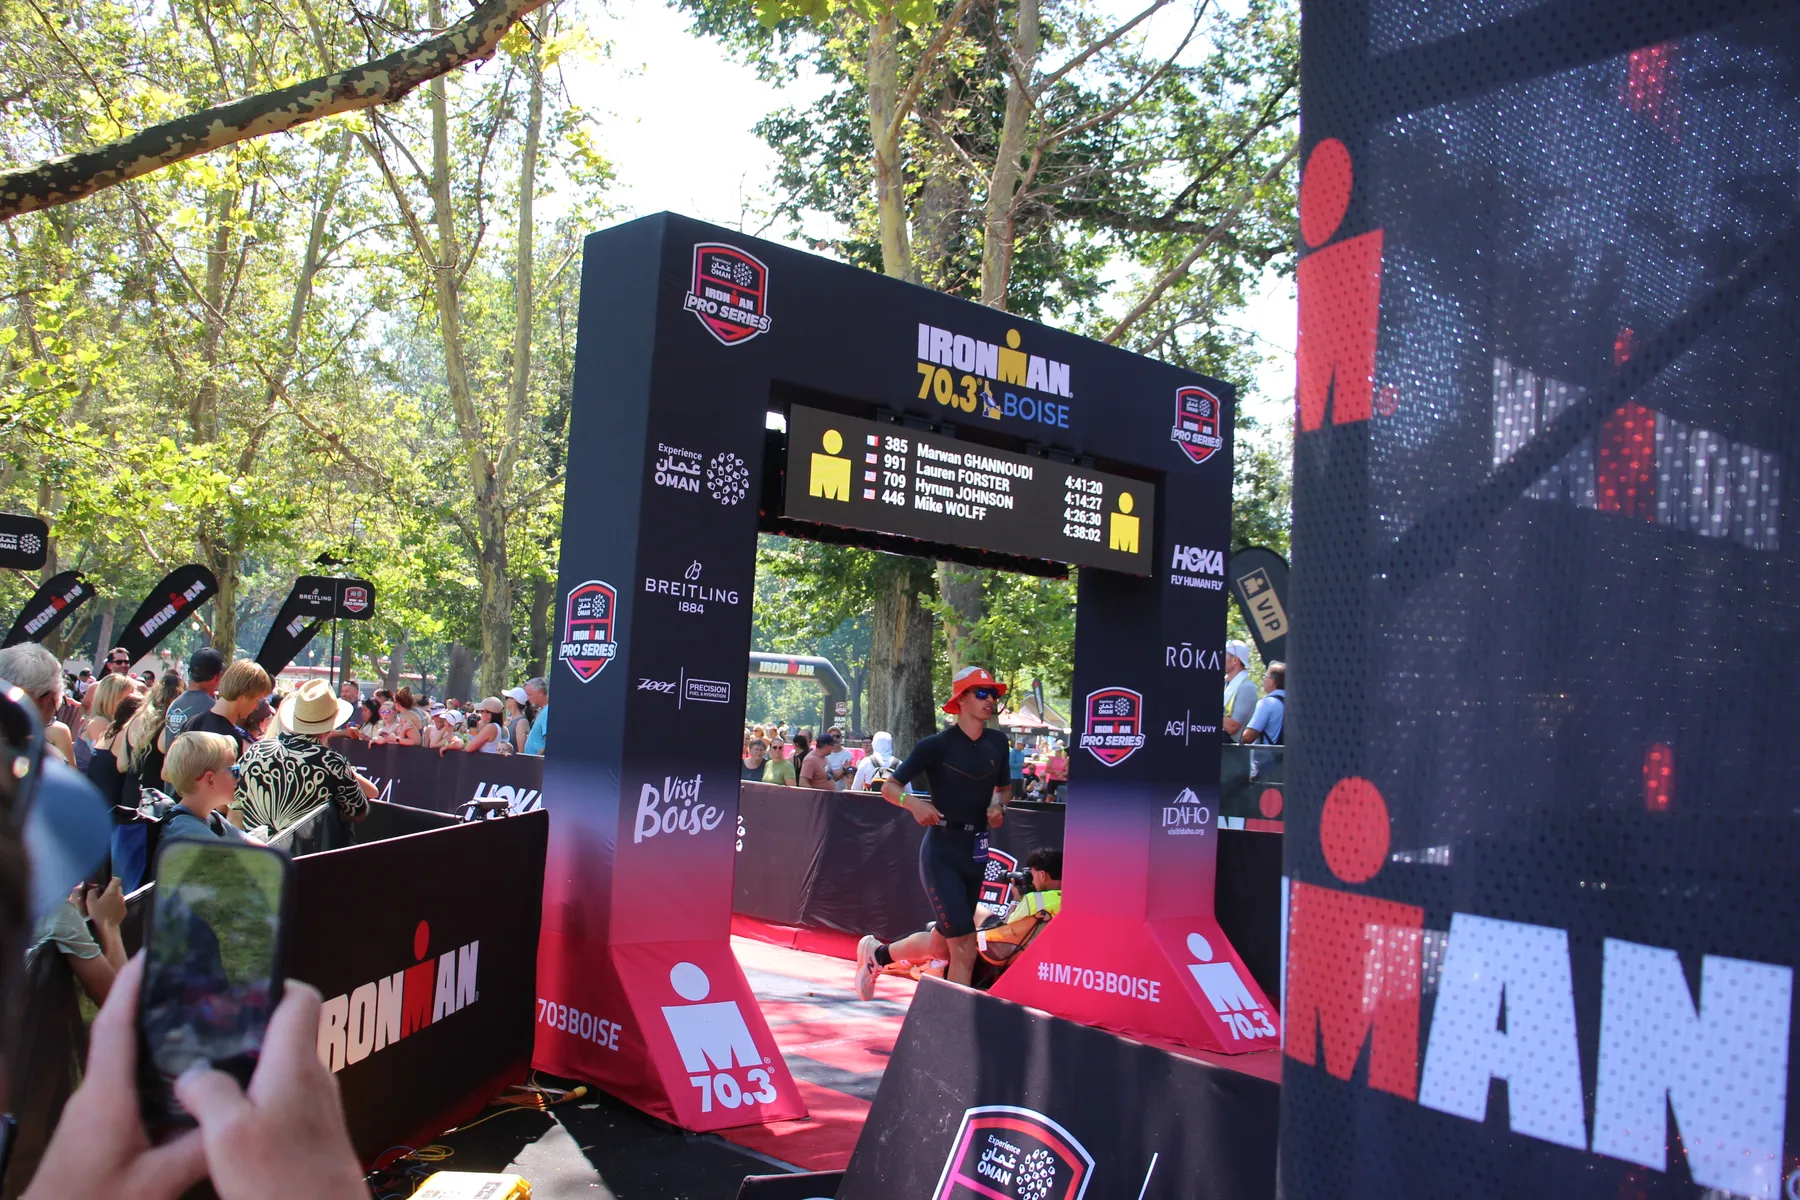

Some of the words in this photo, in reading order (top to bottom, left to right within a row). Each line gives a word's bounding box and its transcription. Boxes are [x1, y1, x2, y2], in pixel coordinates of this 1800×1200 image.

[711, 268, 731, 279] OMAN
[687, 295, 718, 315] PRO
[719, 305, 769, 330] SERIES
[705, 287, 754, 311] IRONMAN
[917, 322, 1071, 398] IRONMAN
[917, 362, 978, 413] 70.3
[1004, 392, 1070, 429] BOISE
[658, 442, 703, 461] Experience
[1173, 428, 1191, 442] PRO
[1191, 433, 1221, 448] SERIES
[885, 436, 908, 454] 385
[917, 443, 961, 465] Marwan
[963, 453, 1033, 480] GHANNOUDI
[1064, 475, 1103, 495] 4:41:20
[654, 471, 700, 493] OMAN
[884, 453, 906, 471] 991
[916, 460, 956, 481] Lauren
[958, 468, 1010, 492] FORSTER
[1064, 491, 1102, 511] 4:14:27
[883, 471, 906, 489] 709
[915, 477, 954, 498] Hyrum
[956, 486, 1014, 510] JOHNSON
[1063, 507, 1102, 526] 4:26:30
[881, 489, 905, 506] 446
[914, 494, 944, 514] Mike
[945, 501, 987, 521] WOLFF
[1063, 523, 1101, 542] 4:38:02
[1171, 544, 1225, 576] HOKA
[645, 577, 739, 605] BREITLING
[1171, 574, 1184, 585] FLY
[1184, 577, 1211, 590] HUMAN
[1211, 581, 1224, 591] FLY
[24, 584, 83, 636] IRONMAN
[139, 579, 207, 638] IRONMAN
[299, 593, 332, 601] BREITLING
[678, 601, 704, 615] 1884
[1256, 597, 1281, 632] VIP
[572, 624, 606, 641] IRONMAN
[561, 643, 581, 657] PRO
[581, 643, 616, 657] SERIES
[759, 658, 816, 676] IRONMAN
[689, 683, 727, 694] PRECISION
[1082, 735, 1105, 746] PRO
[1104, 735, 1143, 746] SERIES
[1190, 724, 1217, 733] ROUVY
[663, 773, 703, 803] Visit
[634, 783, 725, 844] Boise
[1162, 805, 1210, 827] IDAHO
[1037, 961, 1161, 1003] #IM703BOISE
[316, 919, 480, 1074] RONMAN
[1219, 1011, 1277, 1040] 70.3
[689, 1068, 778, 1113] 70.3
[987, 1134, 1021, 1155] Experience
[977, 1160, 1012, 1187] OMAN
